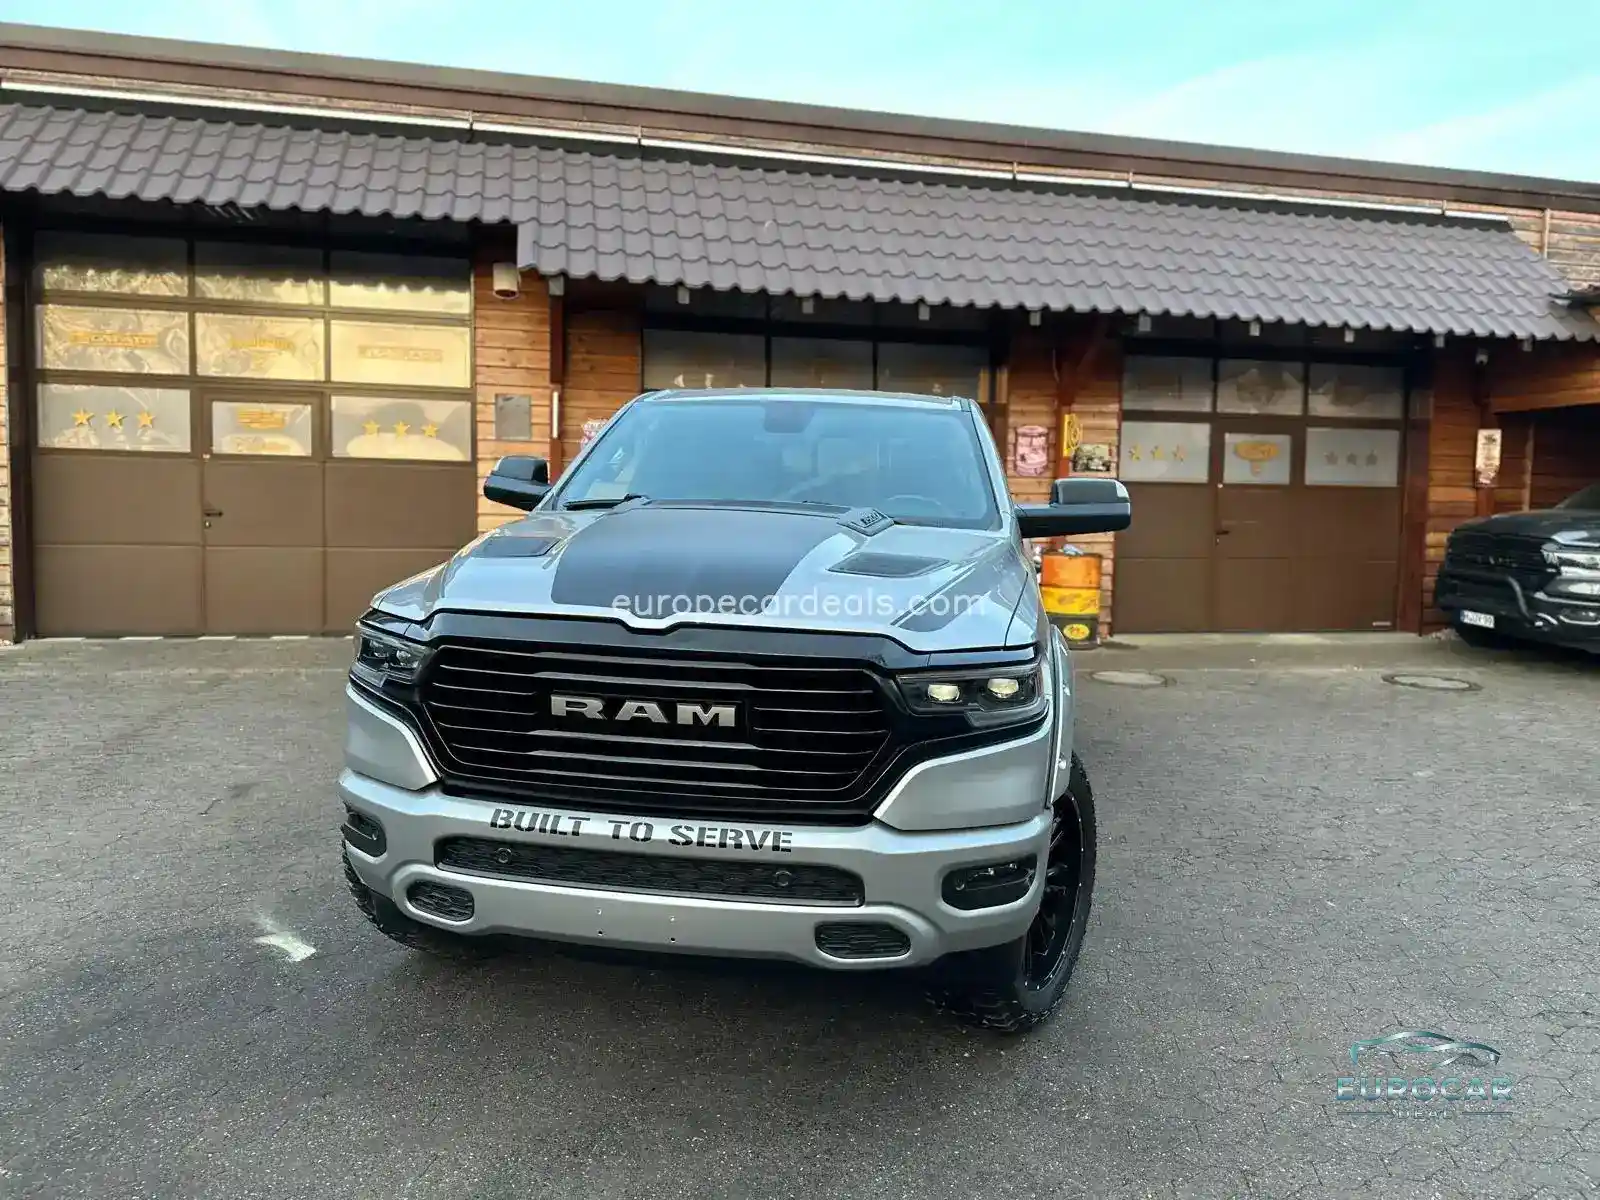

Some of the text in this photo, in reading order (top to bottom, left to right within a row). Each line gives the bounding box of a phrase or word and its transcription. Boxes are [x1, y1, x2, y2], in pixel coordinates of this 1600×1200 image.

[550, 694, 736, 727] RAM
[489, 807, 793, 853] BUILT TO SERVE
